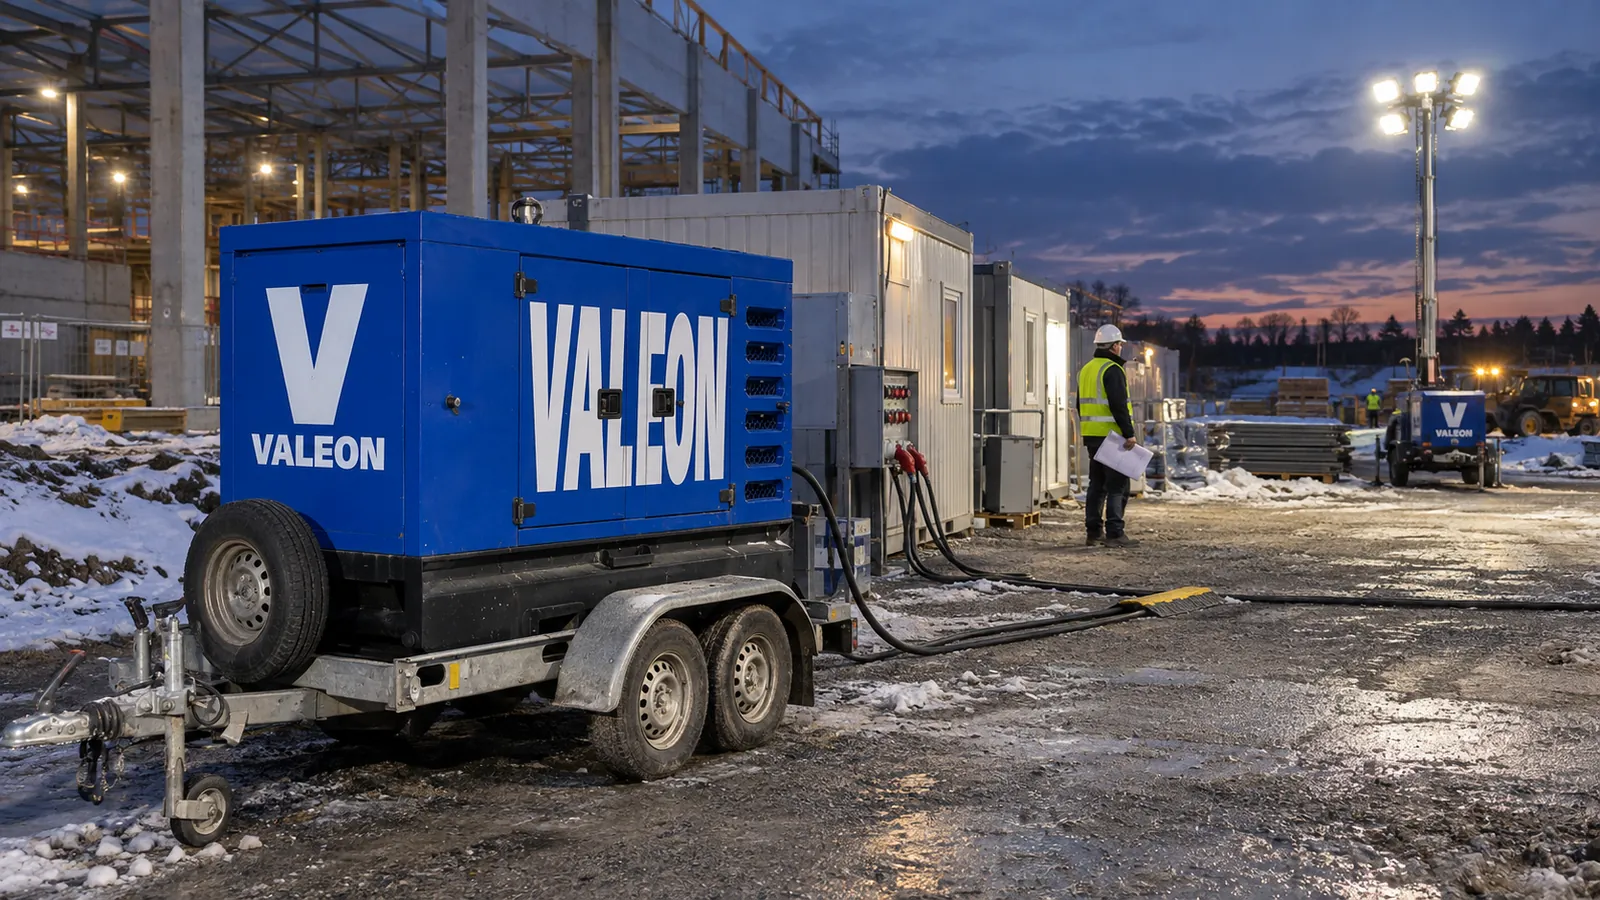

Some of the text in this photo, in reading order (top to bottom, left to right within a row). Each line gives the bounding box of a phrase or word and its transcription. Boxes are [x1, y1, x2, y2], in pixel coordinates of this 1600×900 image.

[266, 283, 369, 425] V
[529, 301, 729, 493] VALEON
[1440, 402, 1468, 428] V
[251, 433, 385, 471] VALEON
[1435, 429, 1473, 438] VALEON
